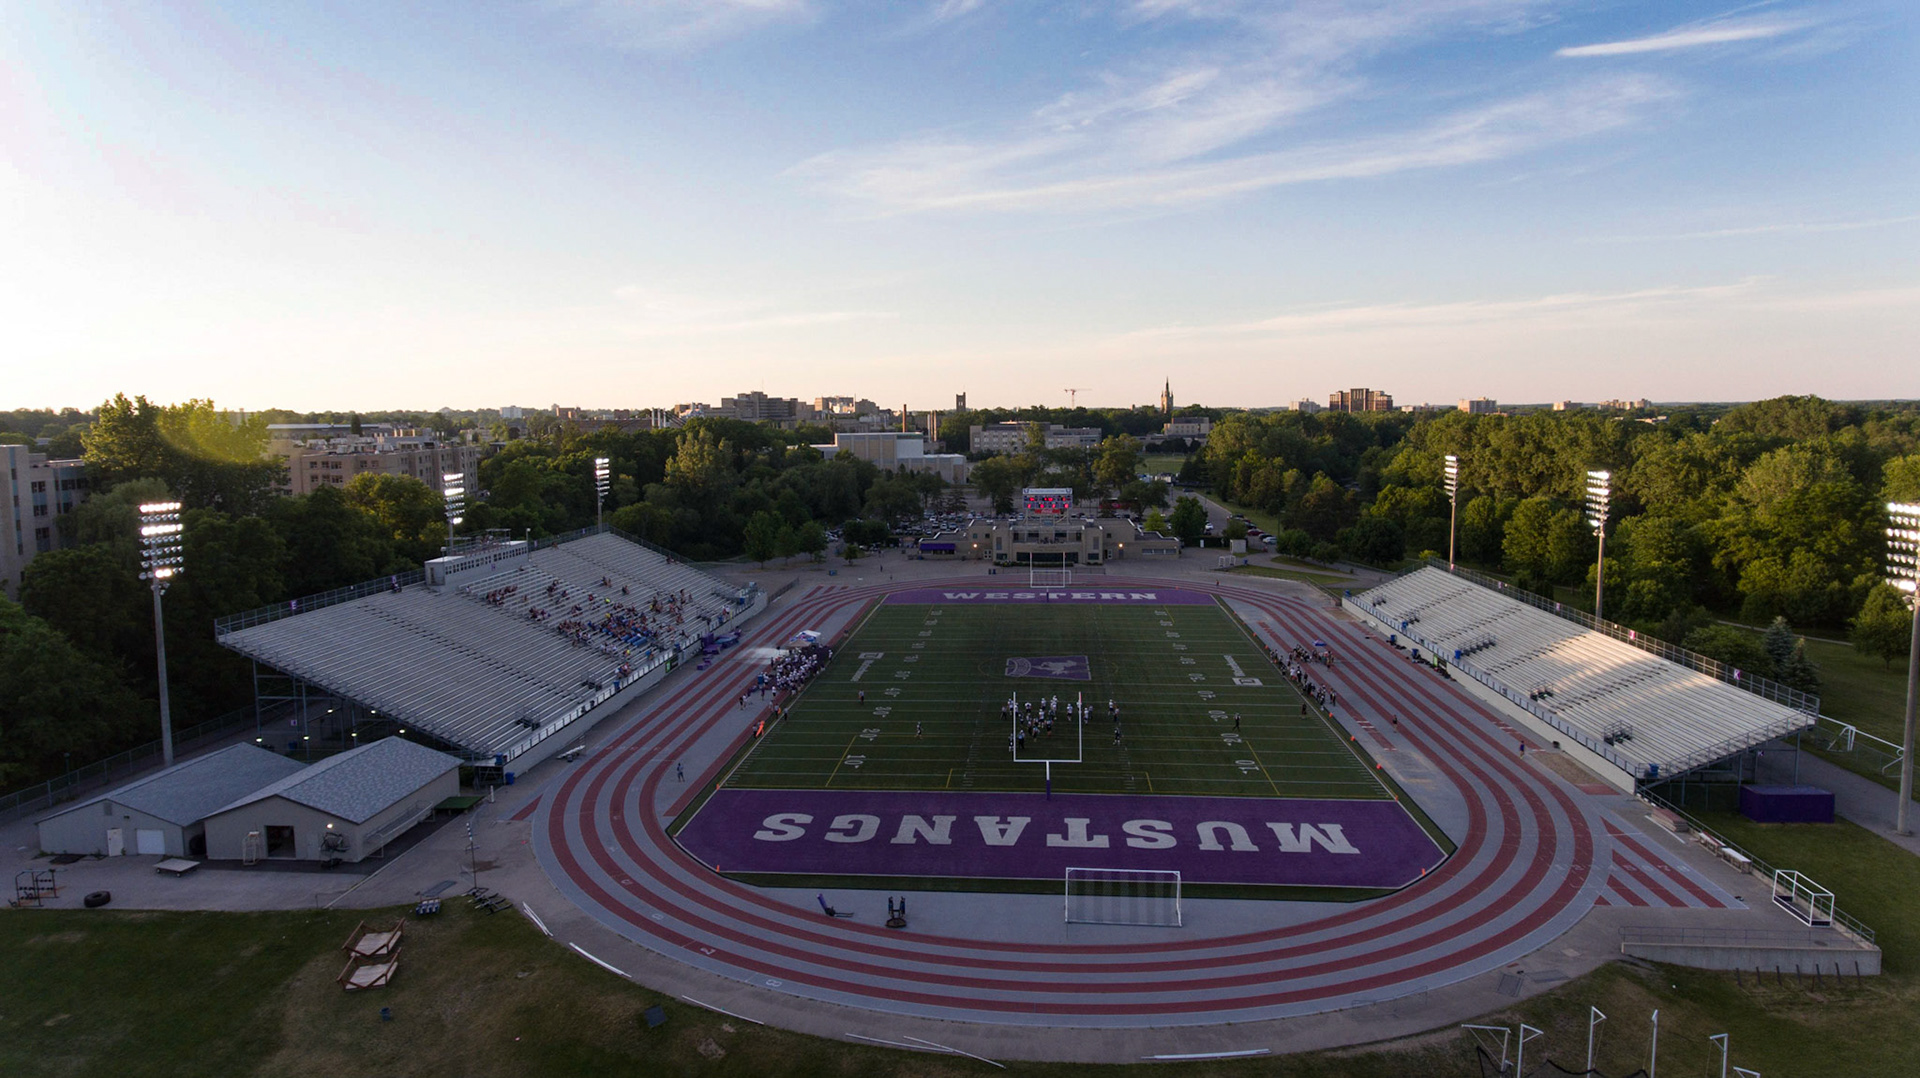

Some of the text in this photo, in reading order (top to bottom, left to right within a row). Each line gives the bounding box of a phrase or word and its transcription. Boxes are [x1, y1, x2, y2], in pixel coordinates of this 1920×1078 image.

[943, 592, 1157, 600] WESTERN
[872, 706, 892, 716] 30
[1208, 710, 1228, 720] 30
[859, 728, 881, 739] 20
[1220, 733, 1242, 744] 20
[844, 754, 866, 766] 10
[1235, 759, 1260, 771] 10
[753, 813, 1361, 855] MUSTANGS
[765, 979, 782, 987] 8
